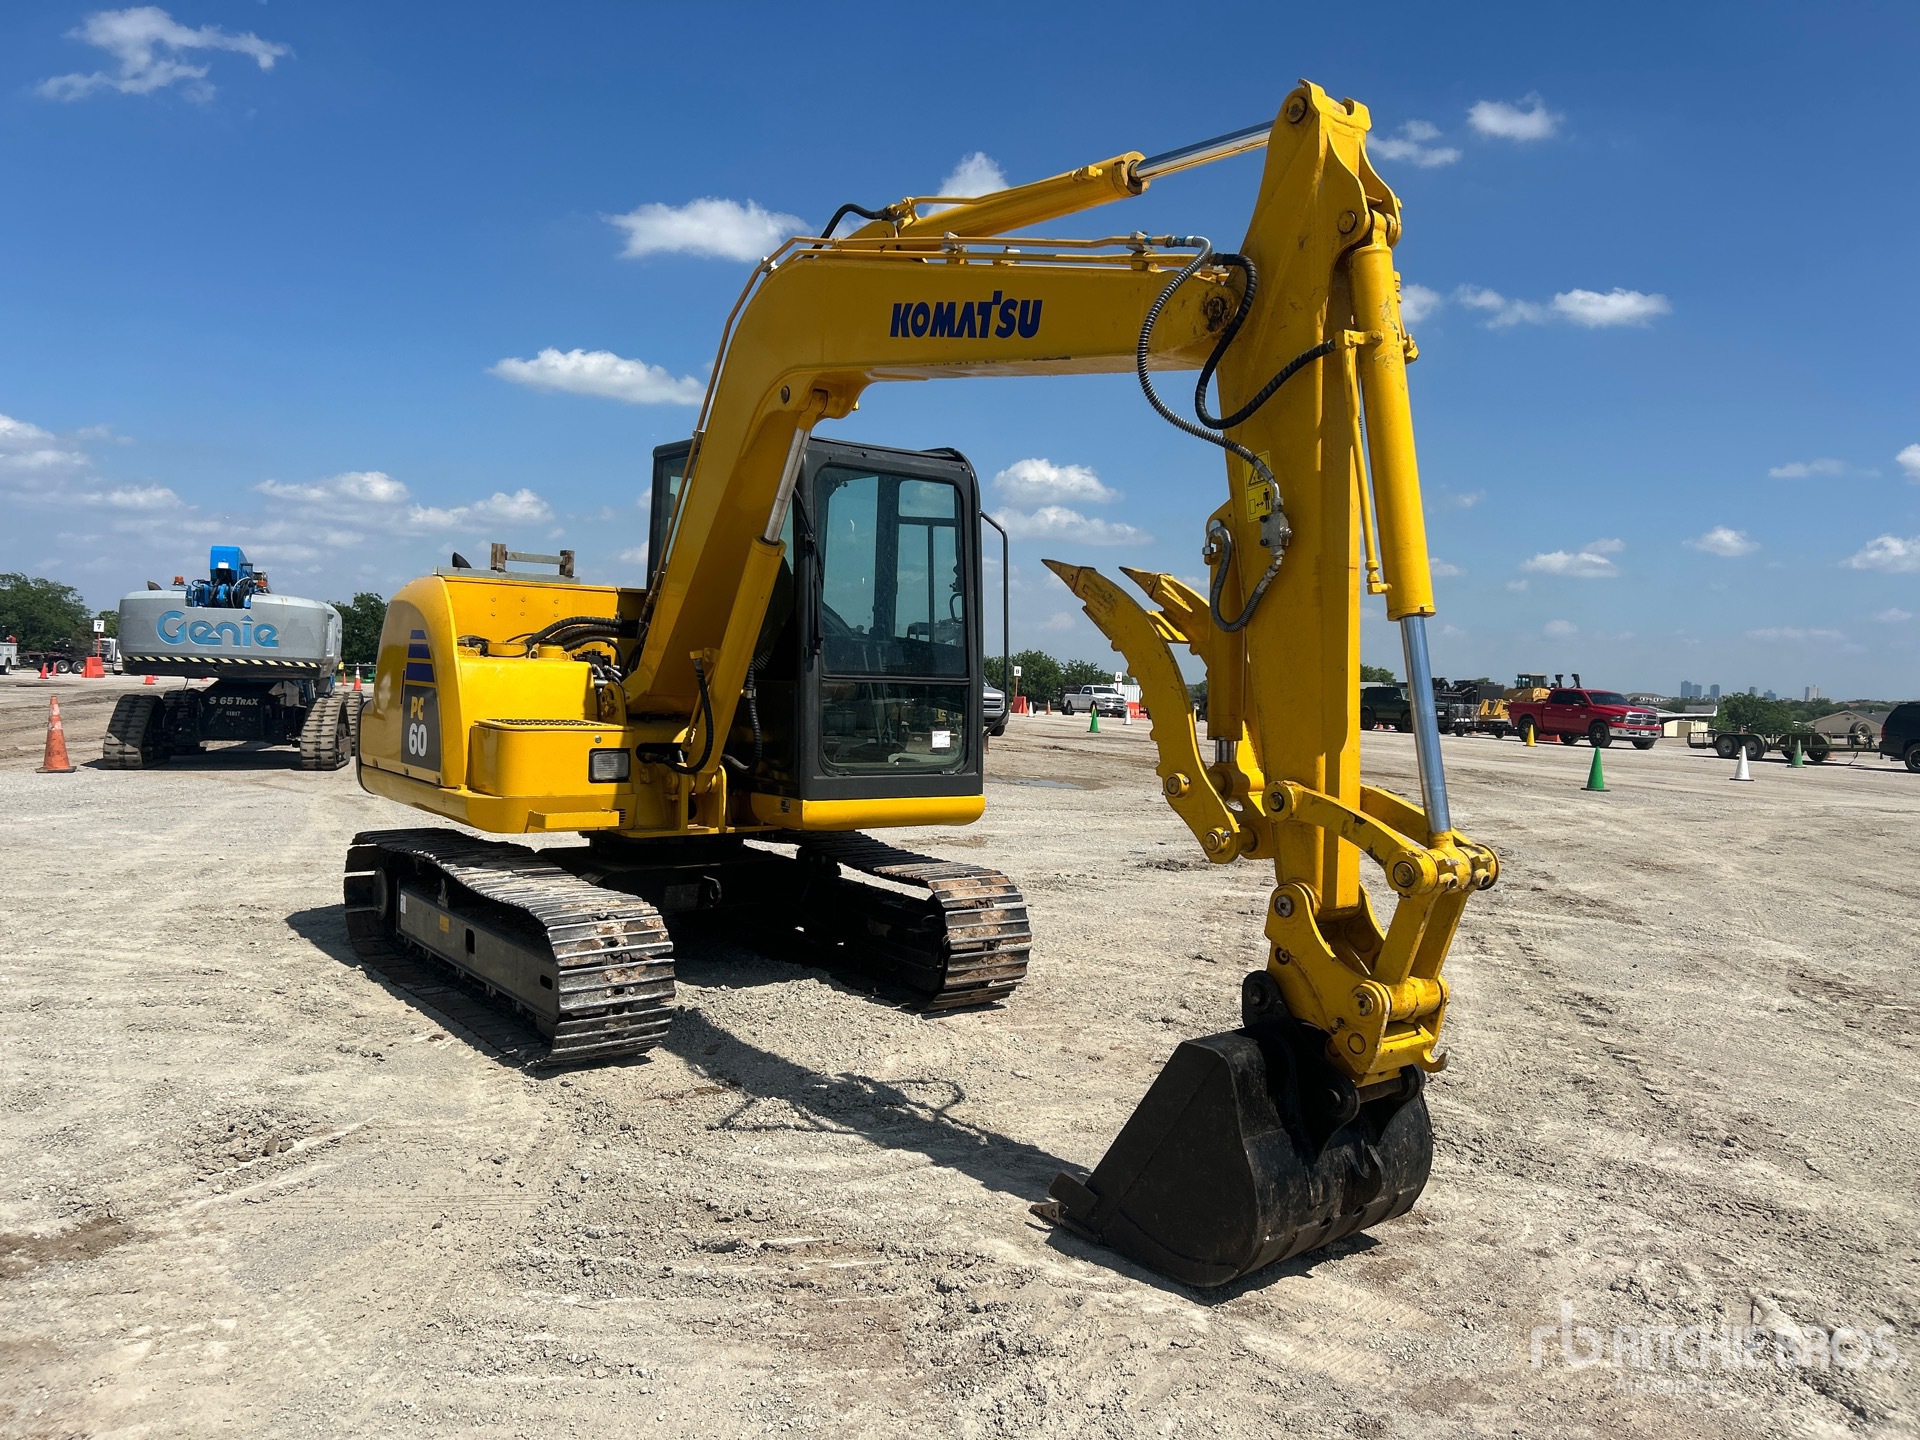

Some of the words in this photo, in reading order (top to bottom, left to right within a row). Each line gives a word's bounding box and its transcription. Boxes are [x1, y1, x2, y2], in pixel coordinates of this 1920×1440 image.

[890, 290, 1043, 338] KOMATSU
[156, 610, 279, 648] Genie
[209, 696, 217, 705] S
[220, 696, 234, 705] 65
[410, 696, 425, 721] PC
[408, 722, 428, 757] 60
